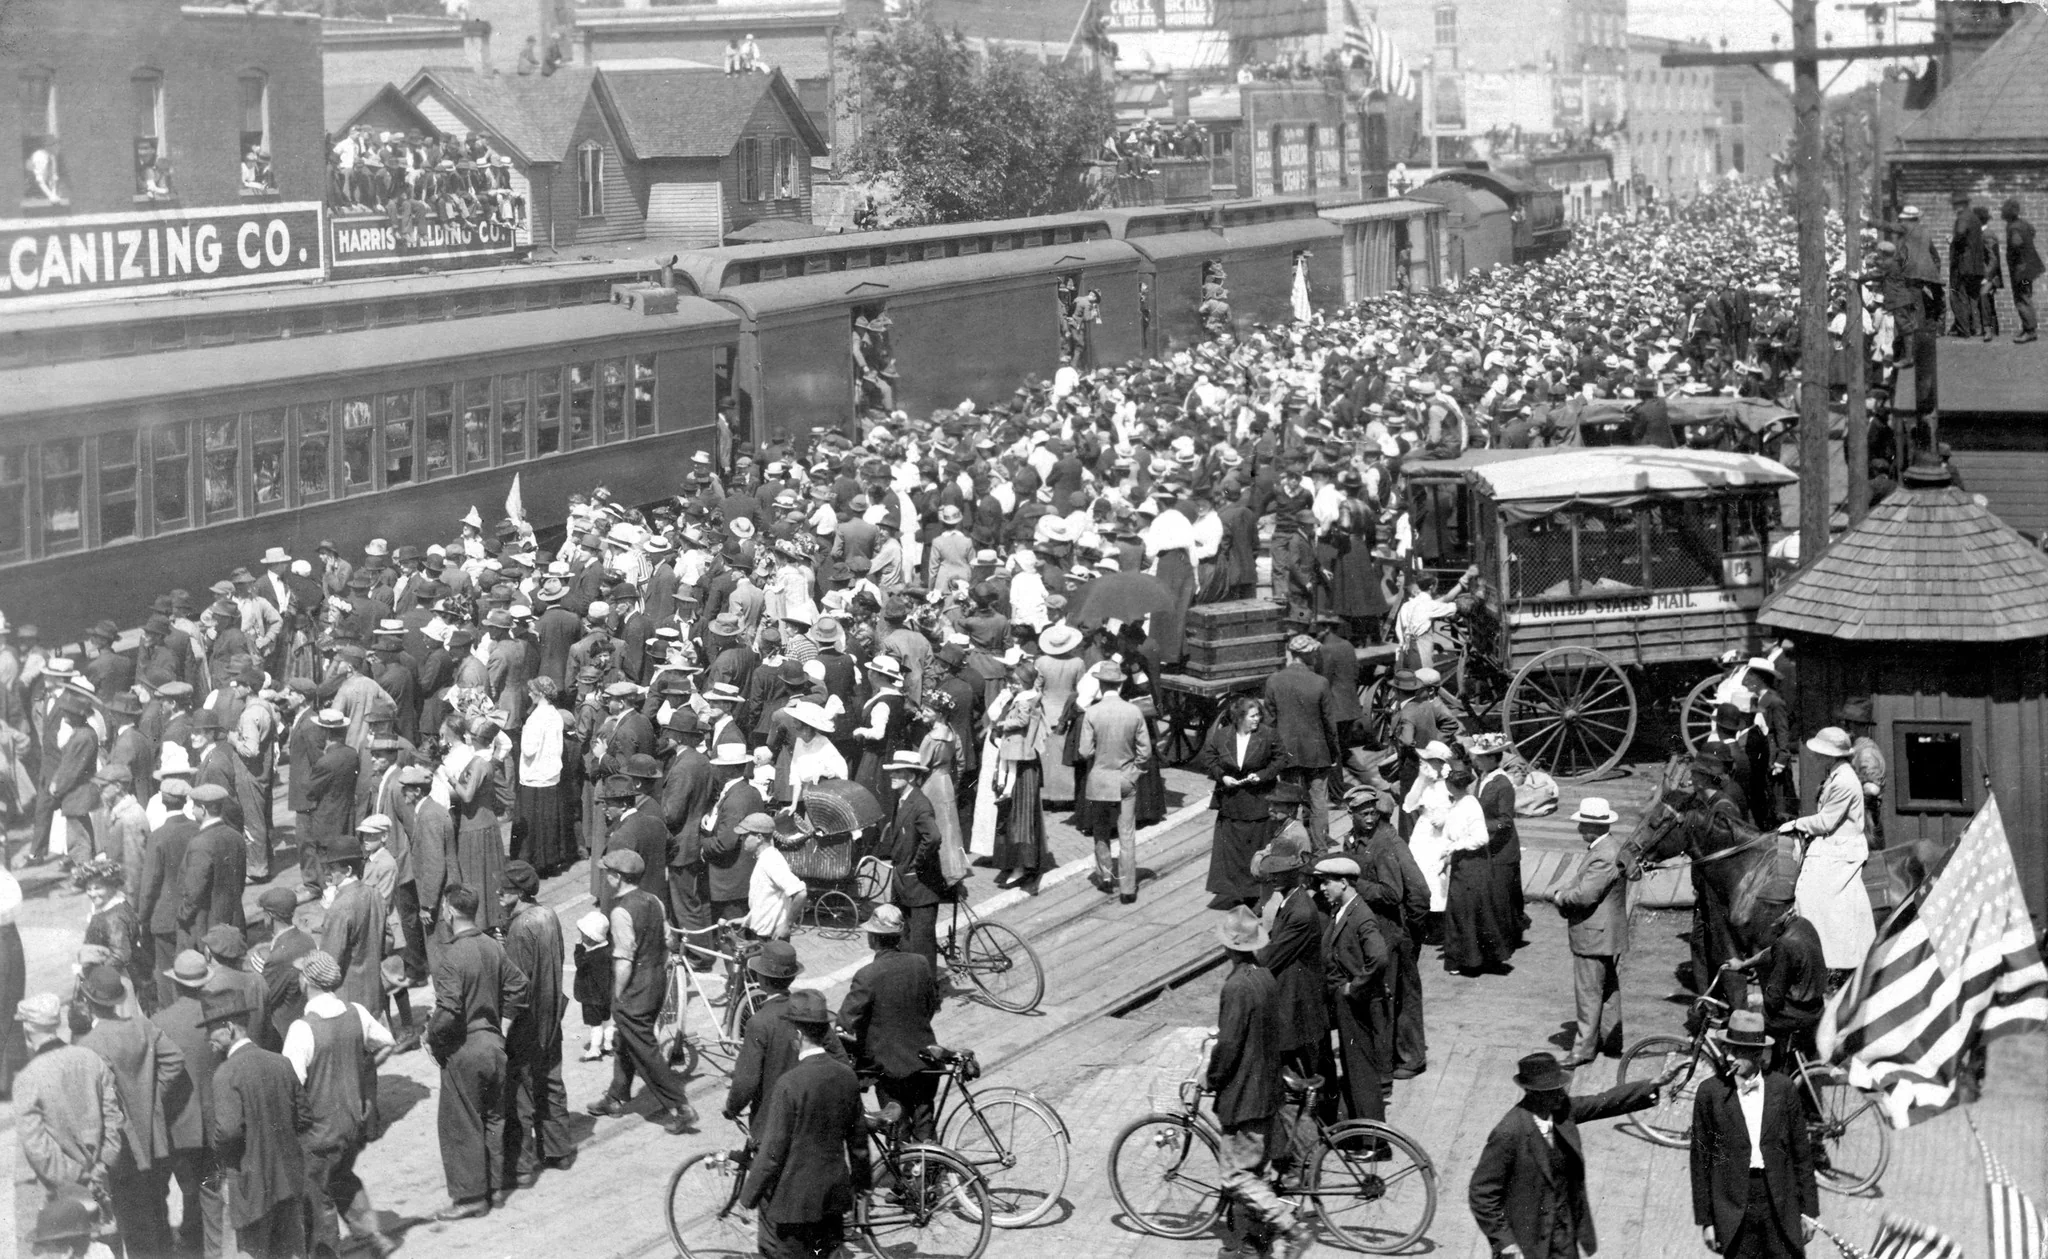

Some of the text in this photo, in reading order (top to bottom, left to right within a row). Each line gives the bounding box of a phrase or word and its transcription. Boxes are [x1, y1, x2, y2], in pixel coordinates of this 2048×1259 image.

[236, 218, 308, 270] CO.
[338, 226, 397, 254] HARRIS
[478, 220, 507, 244] CO.
[1531, 599, 1588, 620] UNITED
[1594, 594, 1652, 614] STATES
[1657, 588, 1698, 610] MAIL.
